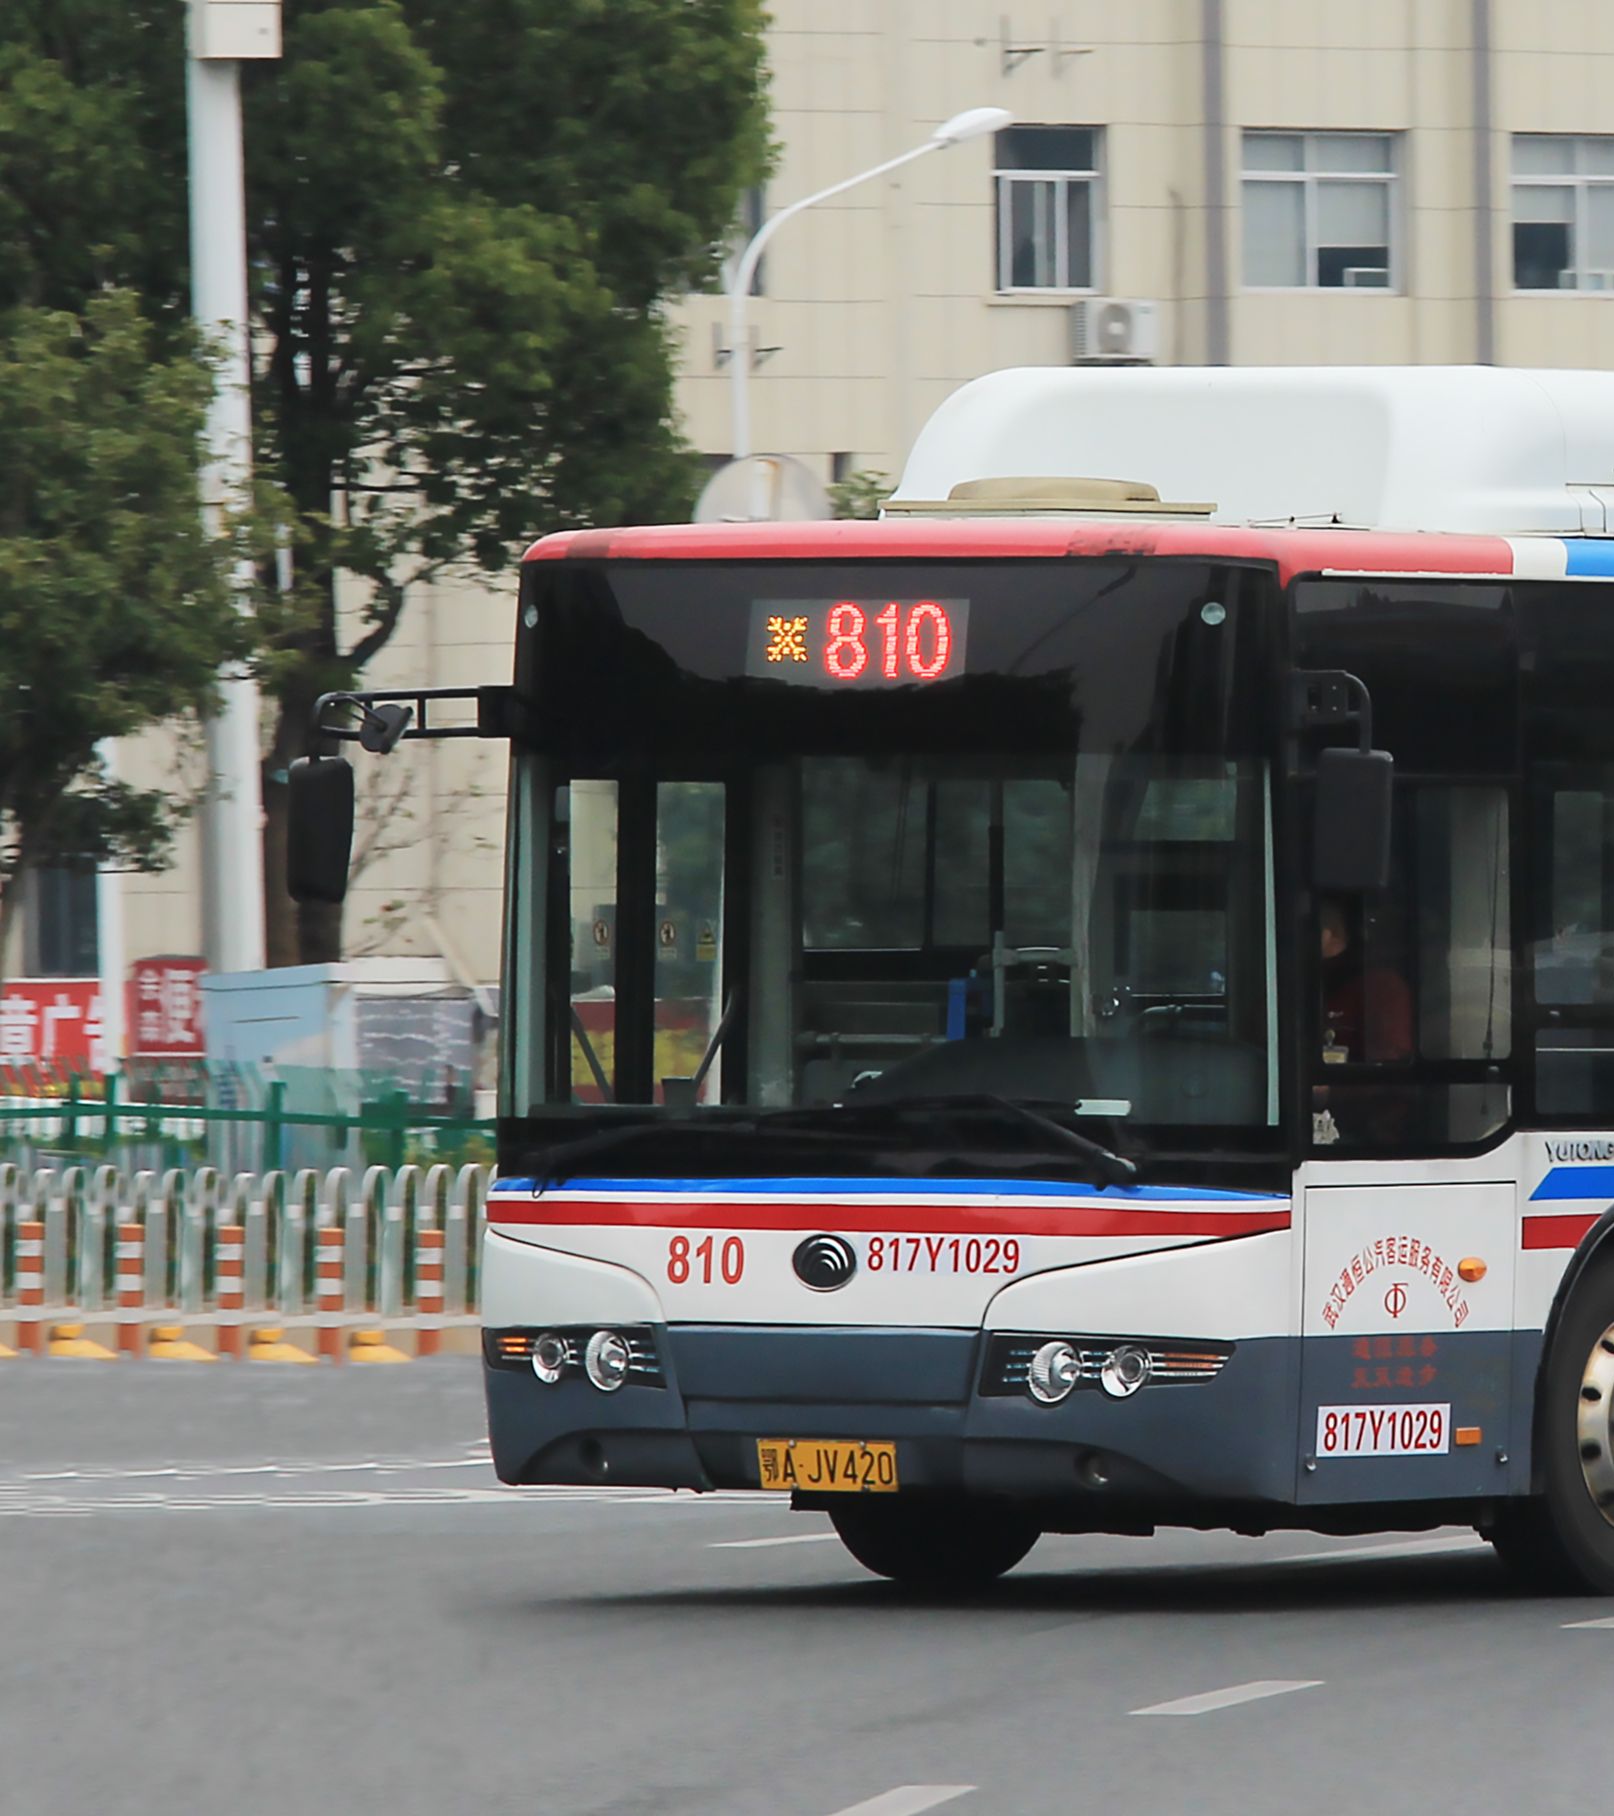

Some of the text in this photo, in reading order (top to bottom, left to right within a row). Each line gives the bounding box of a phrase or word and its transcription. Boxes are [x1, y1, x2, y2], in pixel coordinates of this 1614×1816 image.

[824, 600, 951, 679] 810
[666, 1235, 745, 1284] 810
[867, 1236, 1021, 1274] 817Y1029
[1323, 1408, 1443, 1452] 817Y1029
